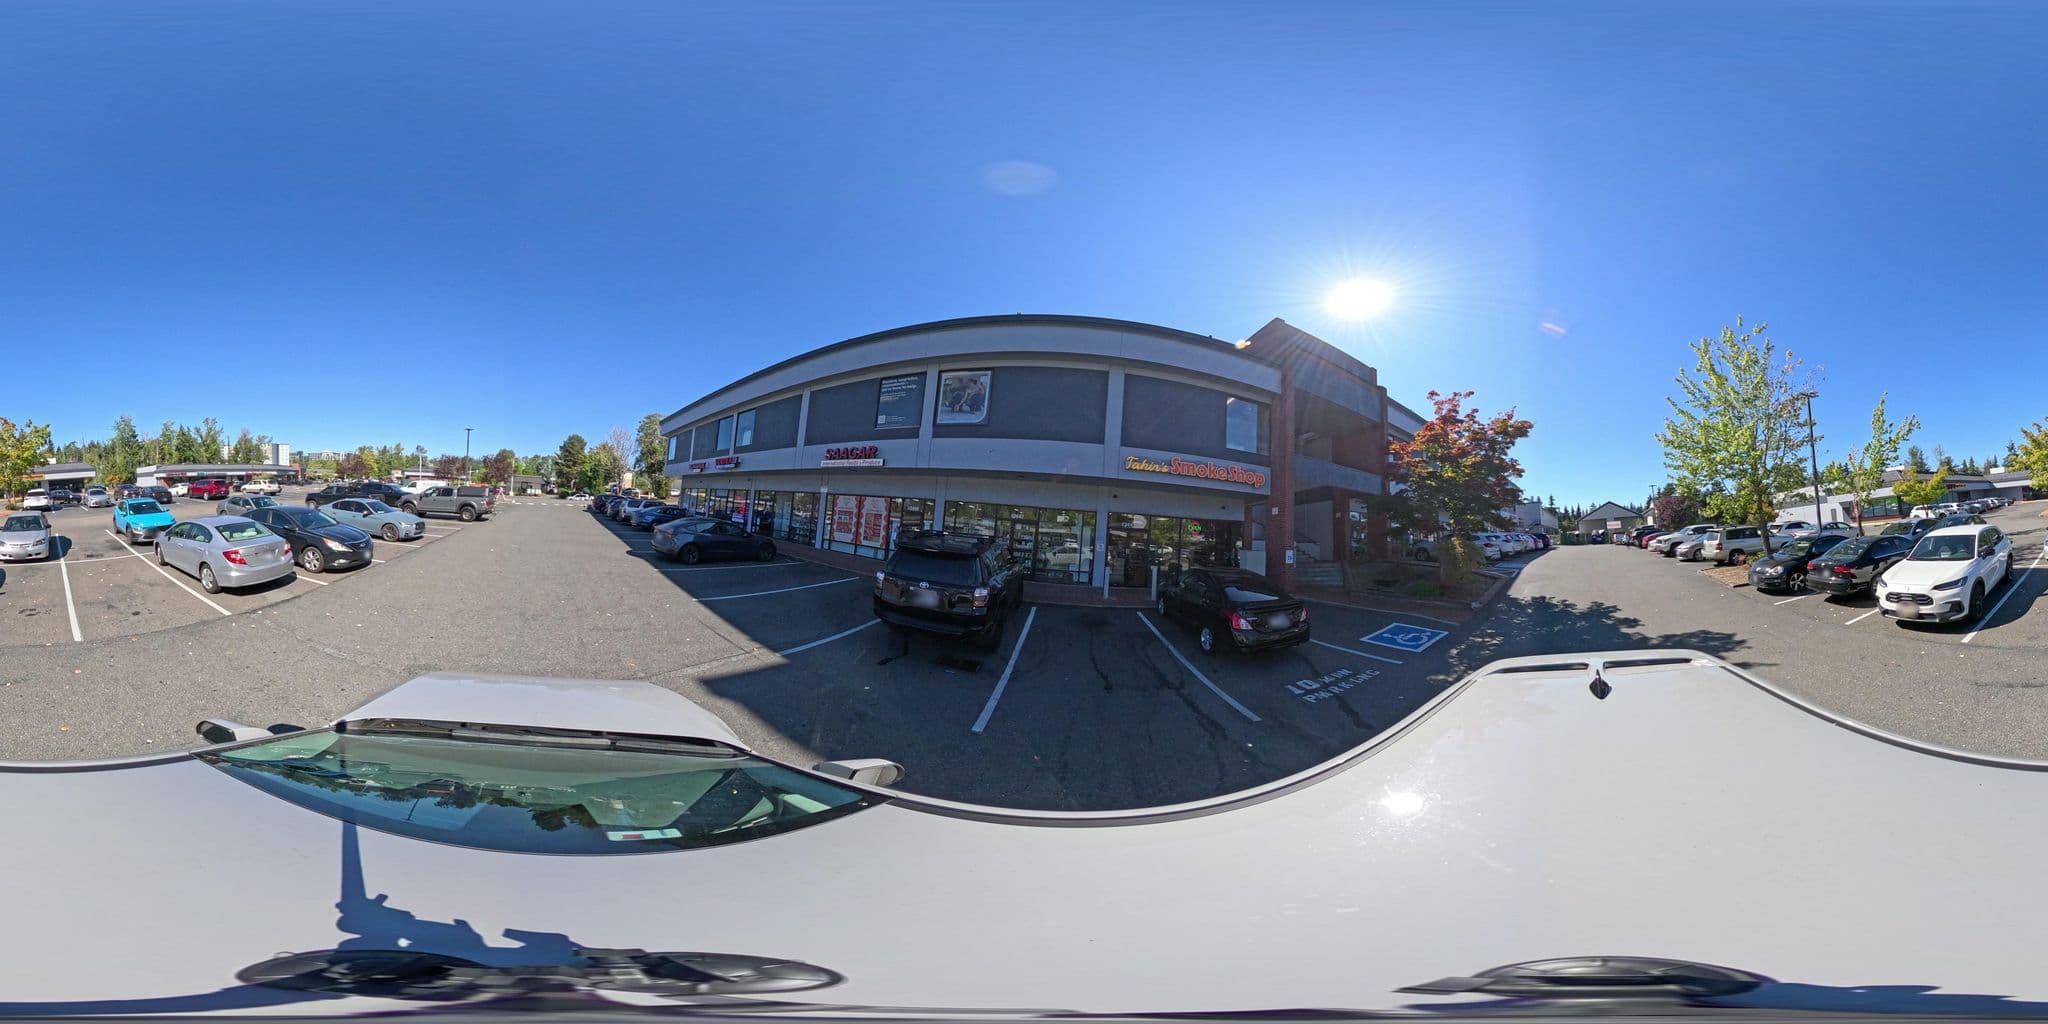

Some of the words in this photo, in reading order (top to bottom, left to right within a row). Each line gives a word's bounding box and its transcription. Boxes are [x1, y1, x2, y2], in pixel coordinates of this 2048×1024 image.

[825, 445, 878, 460] SAAGAR
[1171, 457, 1227, 480] Smoke
[1228, 465, 1265, 488] Shop
[1285, 680, 1321, 694] 10
[1302, 669, 1380, 703] PARKING
